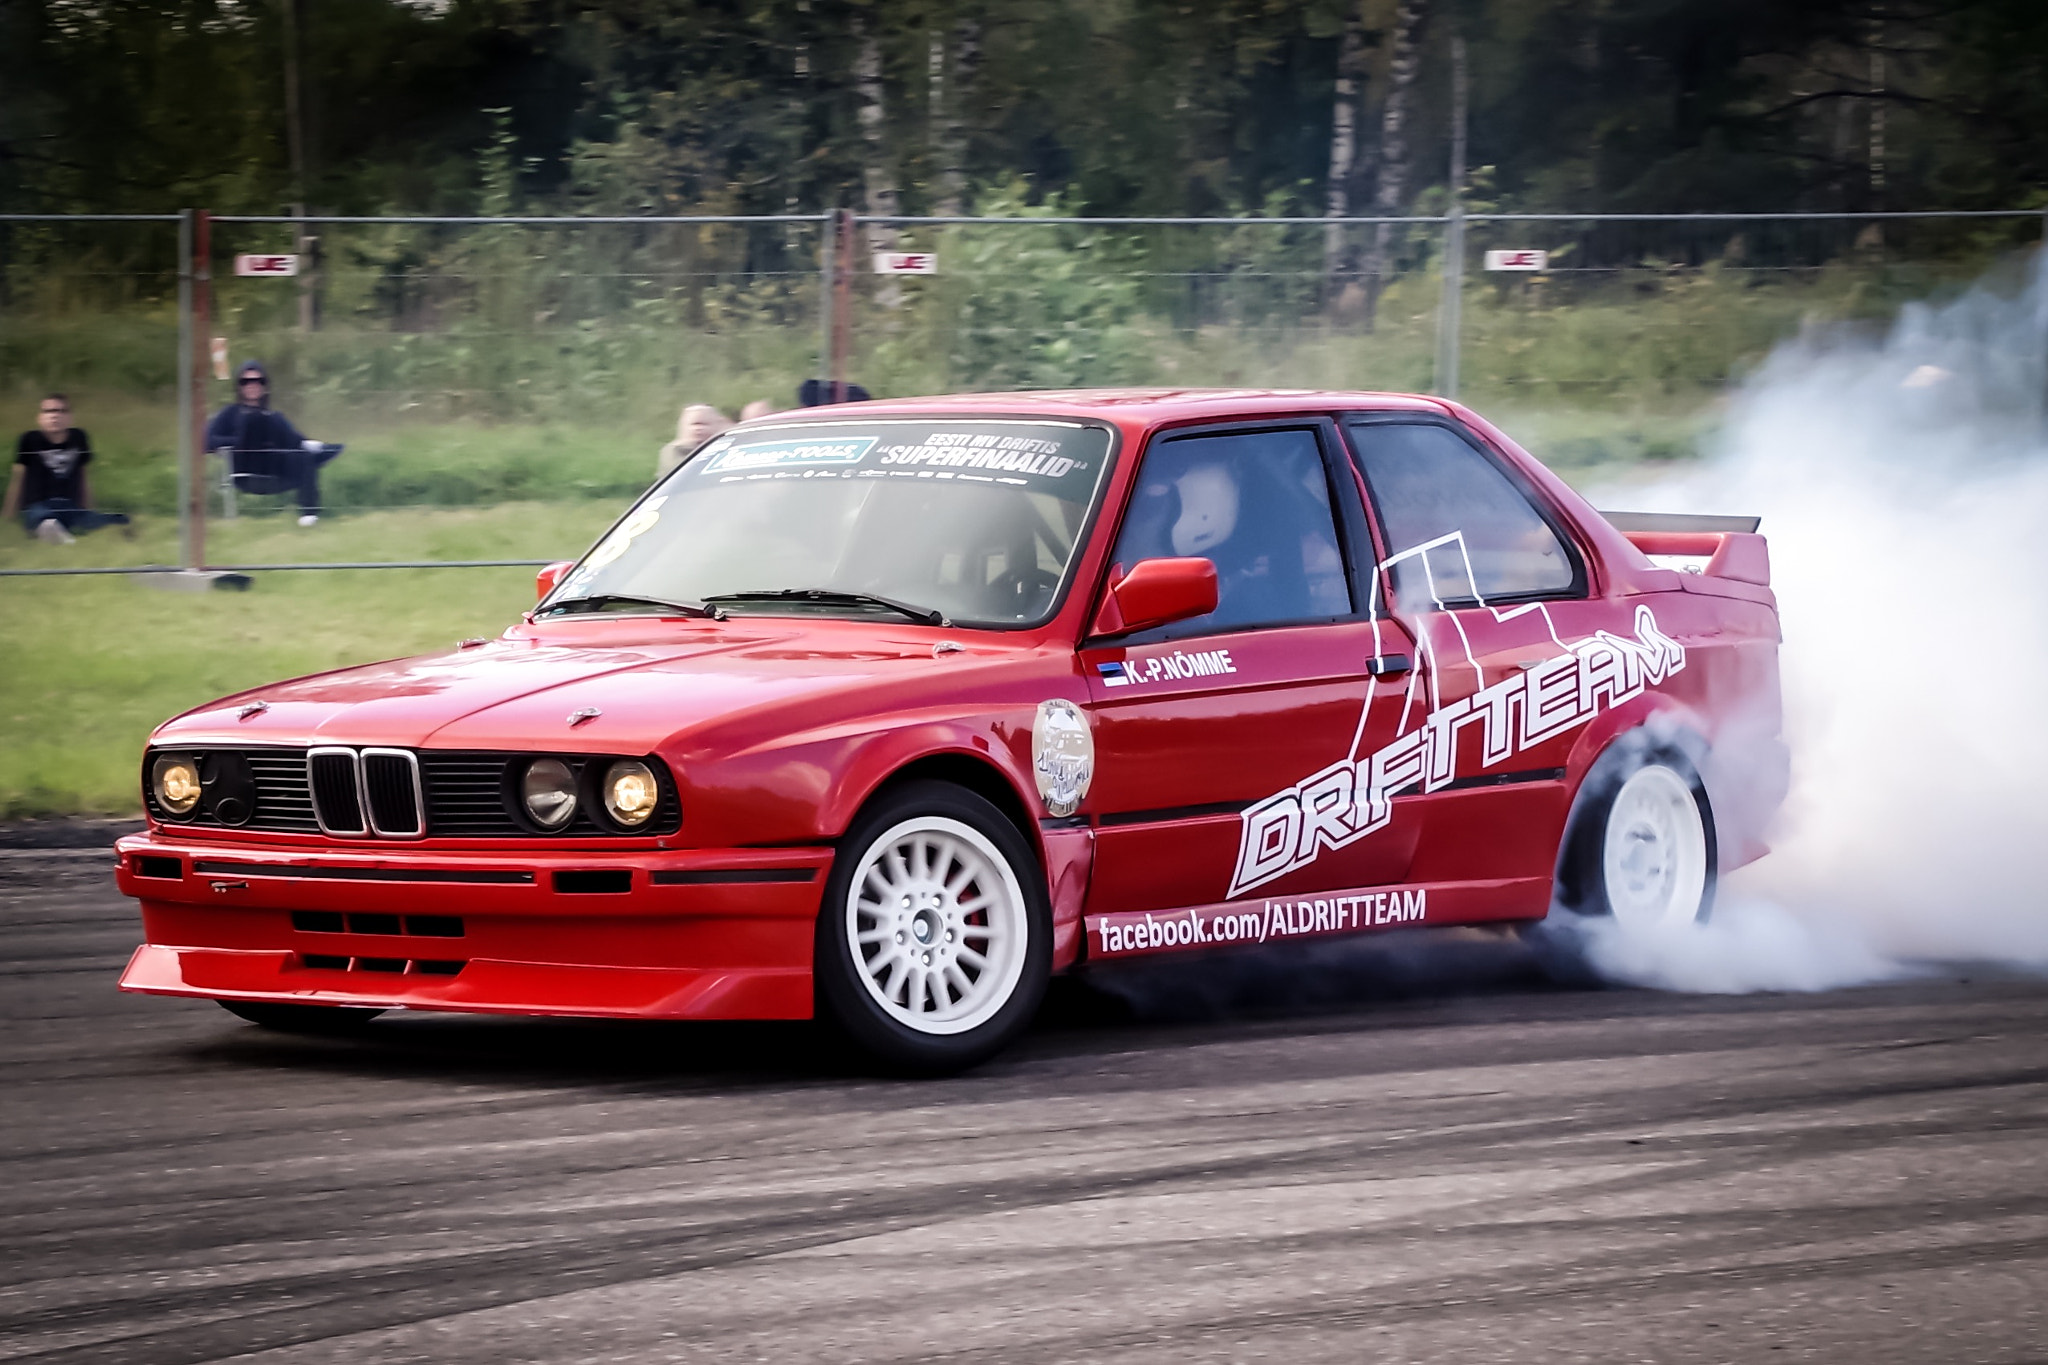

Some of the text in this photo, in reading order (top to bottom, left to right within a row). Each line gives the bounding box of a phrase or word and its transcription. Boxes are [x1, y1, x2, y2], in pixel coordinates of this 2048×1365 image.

[924, 433, 1061, 454] EESTI MV DRIFTIS
[1099, 889, 1426, 952] facebook.com/ALDRIFTTEAM
